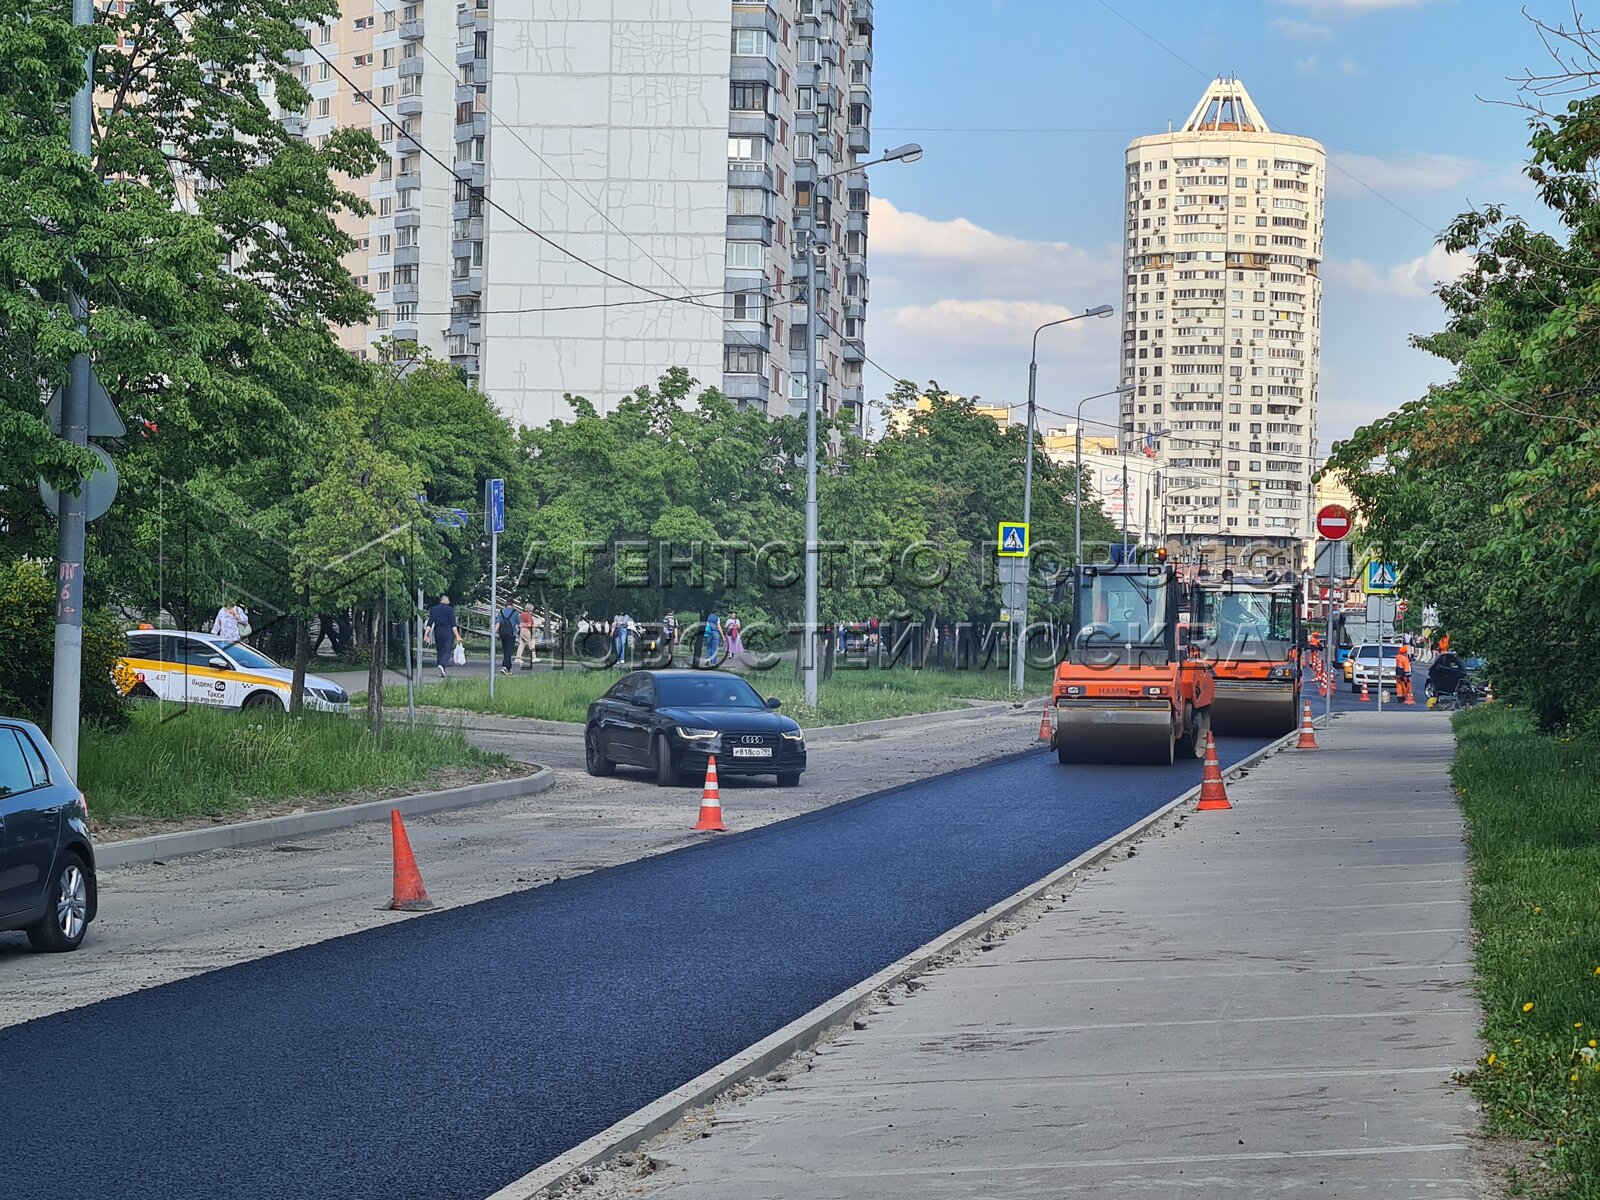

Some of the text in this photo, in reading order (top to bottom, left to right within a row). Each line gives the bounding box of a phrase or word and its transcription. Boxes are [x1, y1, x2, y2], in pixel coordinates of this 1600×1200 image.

[191, 678, 226, 691] Яндекс Go
[207, 690, 225, 698] Такси
